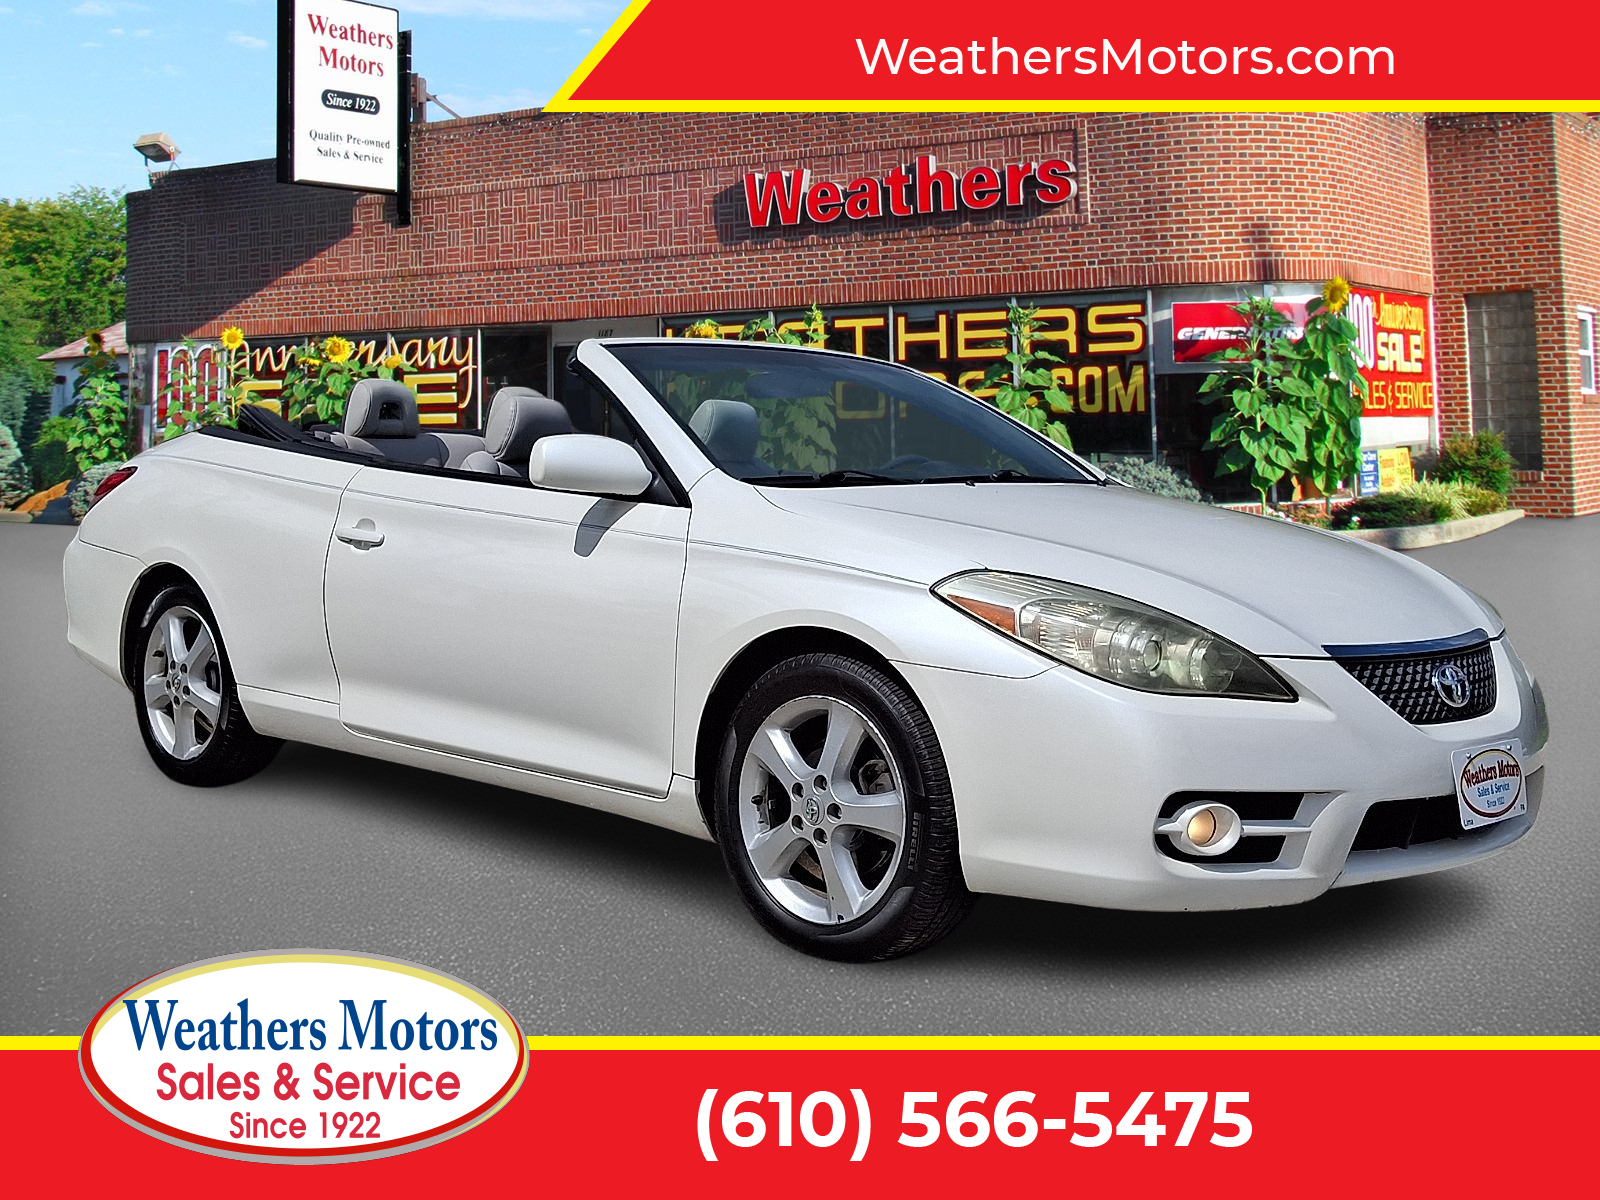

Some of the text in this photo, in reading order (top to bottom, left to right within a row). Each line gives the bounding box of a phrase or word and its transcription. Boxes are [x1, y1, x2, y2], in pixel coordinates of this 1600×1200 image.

[307, 13, 394, 50] Weathers
[318, 45, 385, 77] Motors
[325, 92, 376, 112] Since 1922
[309, 128, 390, 149] Quality Pre-owned
[316, 145, 384, 164] Sales & Service
[743, 154, 1077, 228] Weathers
[598, 328, 614, 338] 1187
[1376, 331, 1423, 373] SALE
[1394, 381, 1434, 409] SERVICE
[1464, 760, 1520, 789] Weathers Motors
[1477, 786, 1492, 798] Sales
[1494, 782, 1510, 794] Service
